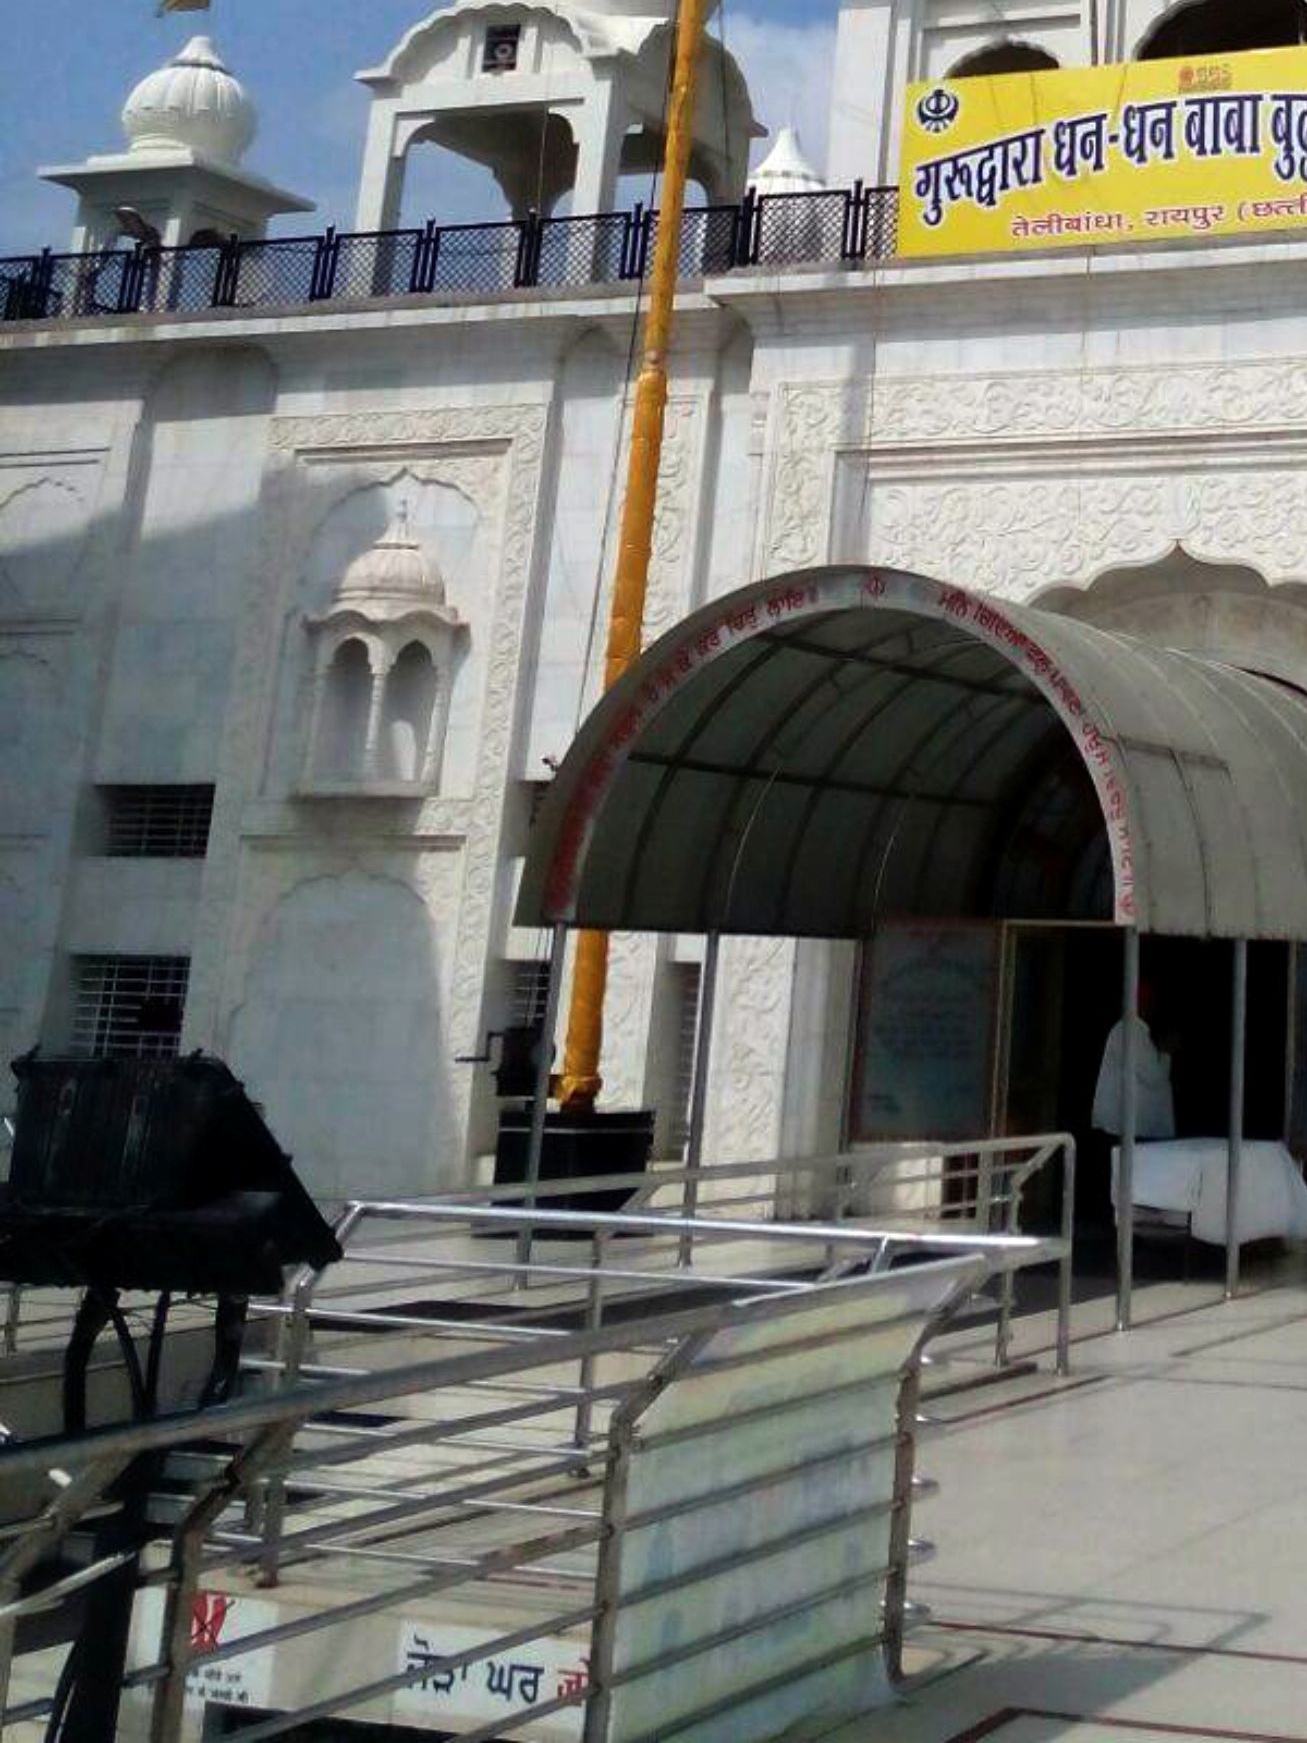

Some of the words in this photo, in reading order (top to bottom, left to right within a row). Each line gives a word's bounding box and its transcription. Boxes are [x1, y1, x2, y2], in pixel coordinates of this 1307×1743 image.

[916, 128, 1046, 226] गुरूद्वारा
[1185, 94, 1263, 157] बाबा
[1144, 204, 1224, 229] रायपुर
[486, 1660, 546, 1704] ਘਰ
